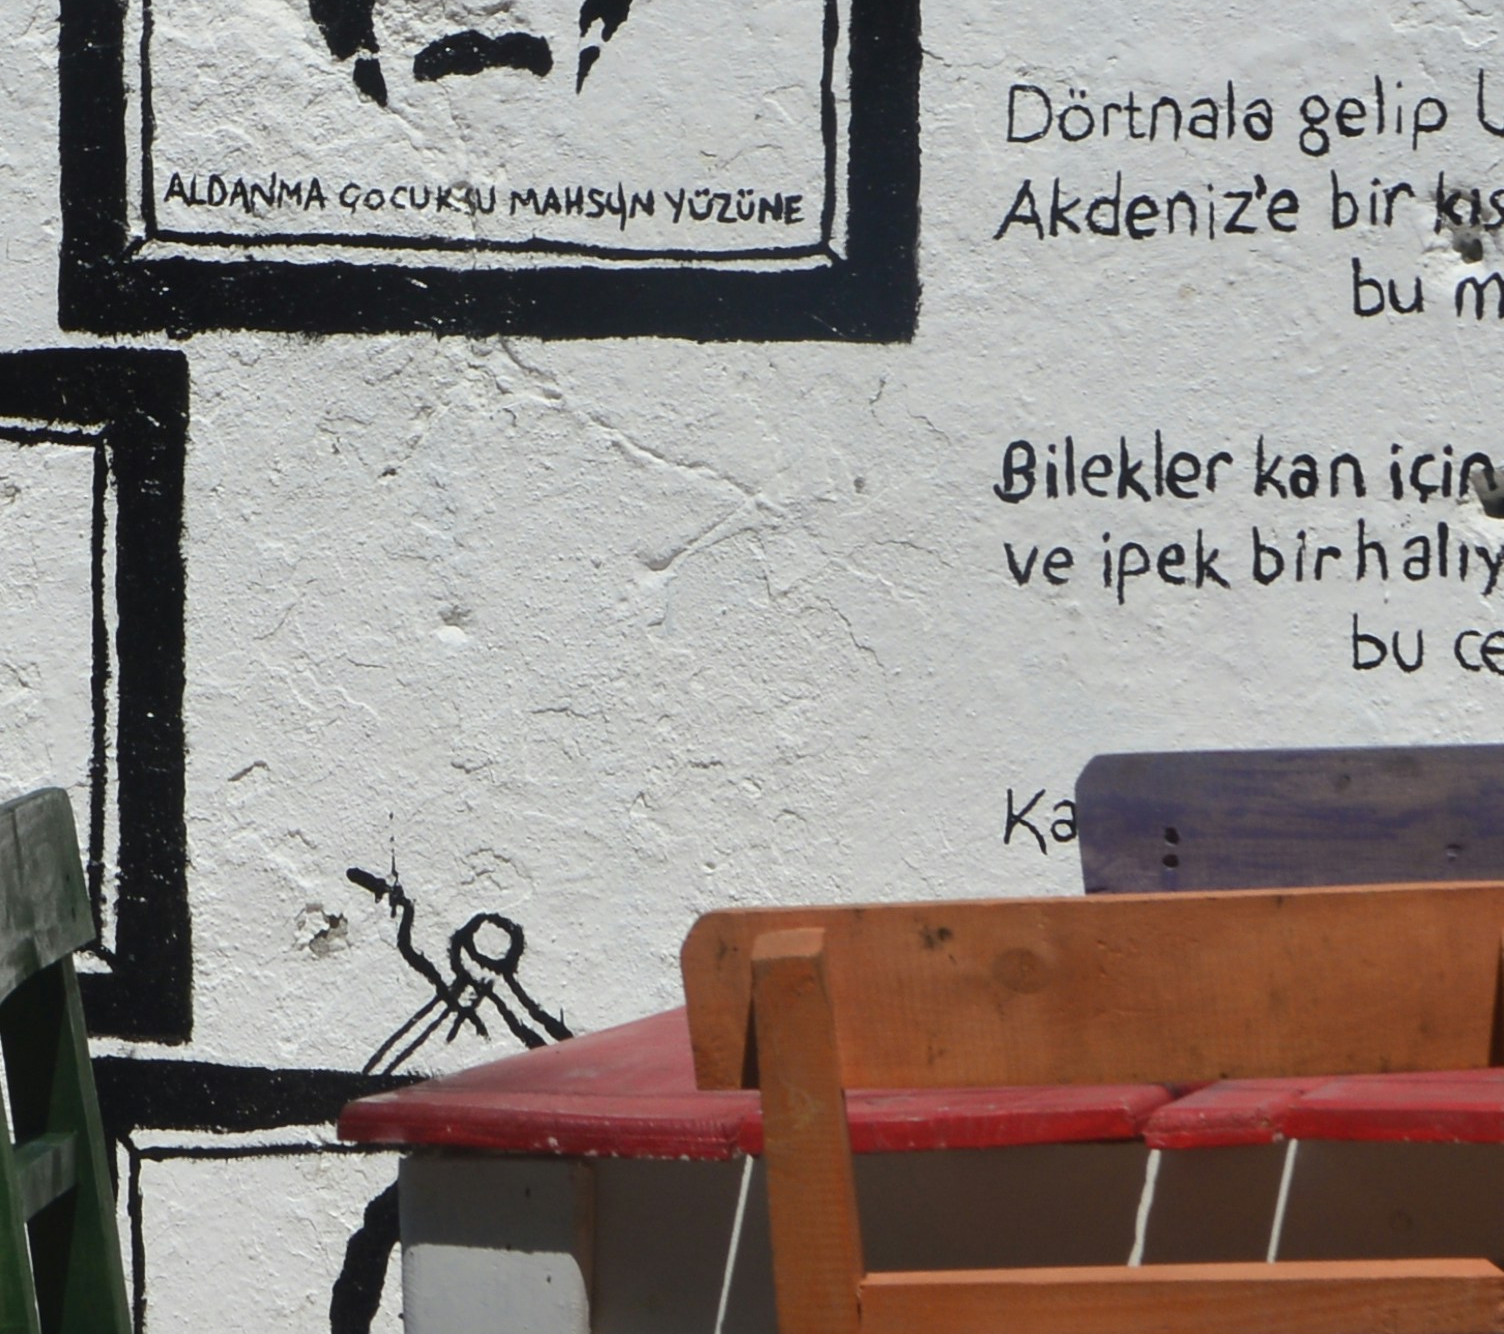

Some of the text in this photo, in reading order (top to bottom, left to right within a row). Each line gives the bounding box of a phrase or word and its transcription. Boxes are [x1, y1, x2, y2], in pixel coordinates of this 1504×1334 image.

[1007, 81, 1273, 143] Dörtnala
[1299, 76, 1448, 157] gelip
[164, 173, 327, 214] ALDANMA
[664, 188, 802, 225] YÜZÜNE
[1331, 172, 1415, 230] bir
[1352, 257, 1424, 317] bu
[993, 430, 1233, 504] Bilekler
[1254, 439, 1366, 499] kan
[1004, 543, 1074, 586] ve
[1102, 530, 1229, 605] ipek
[1252, 527, 1341, 586] bir
[1352, 615, 1424, 673] bu
